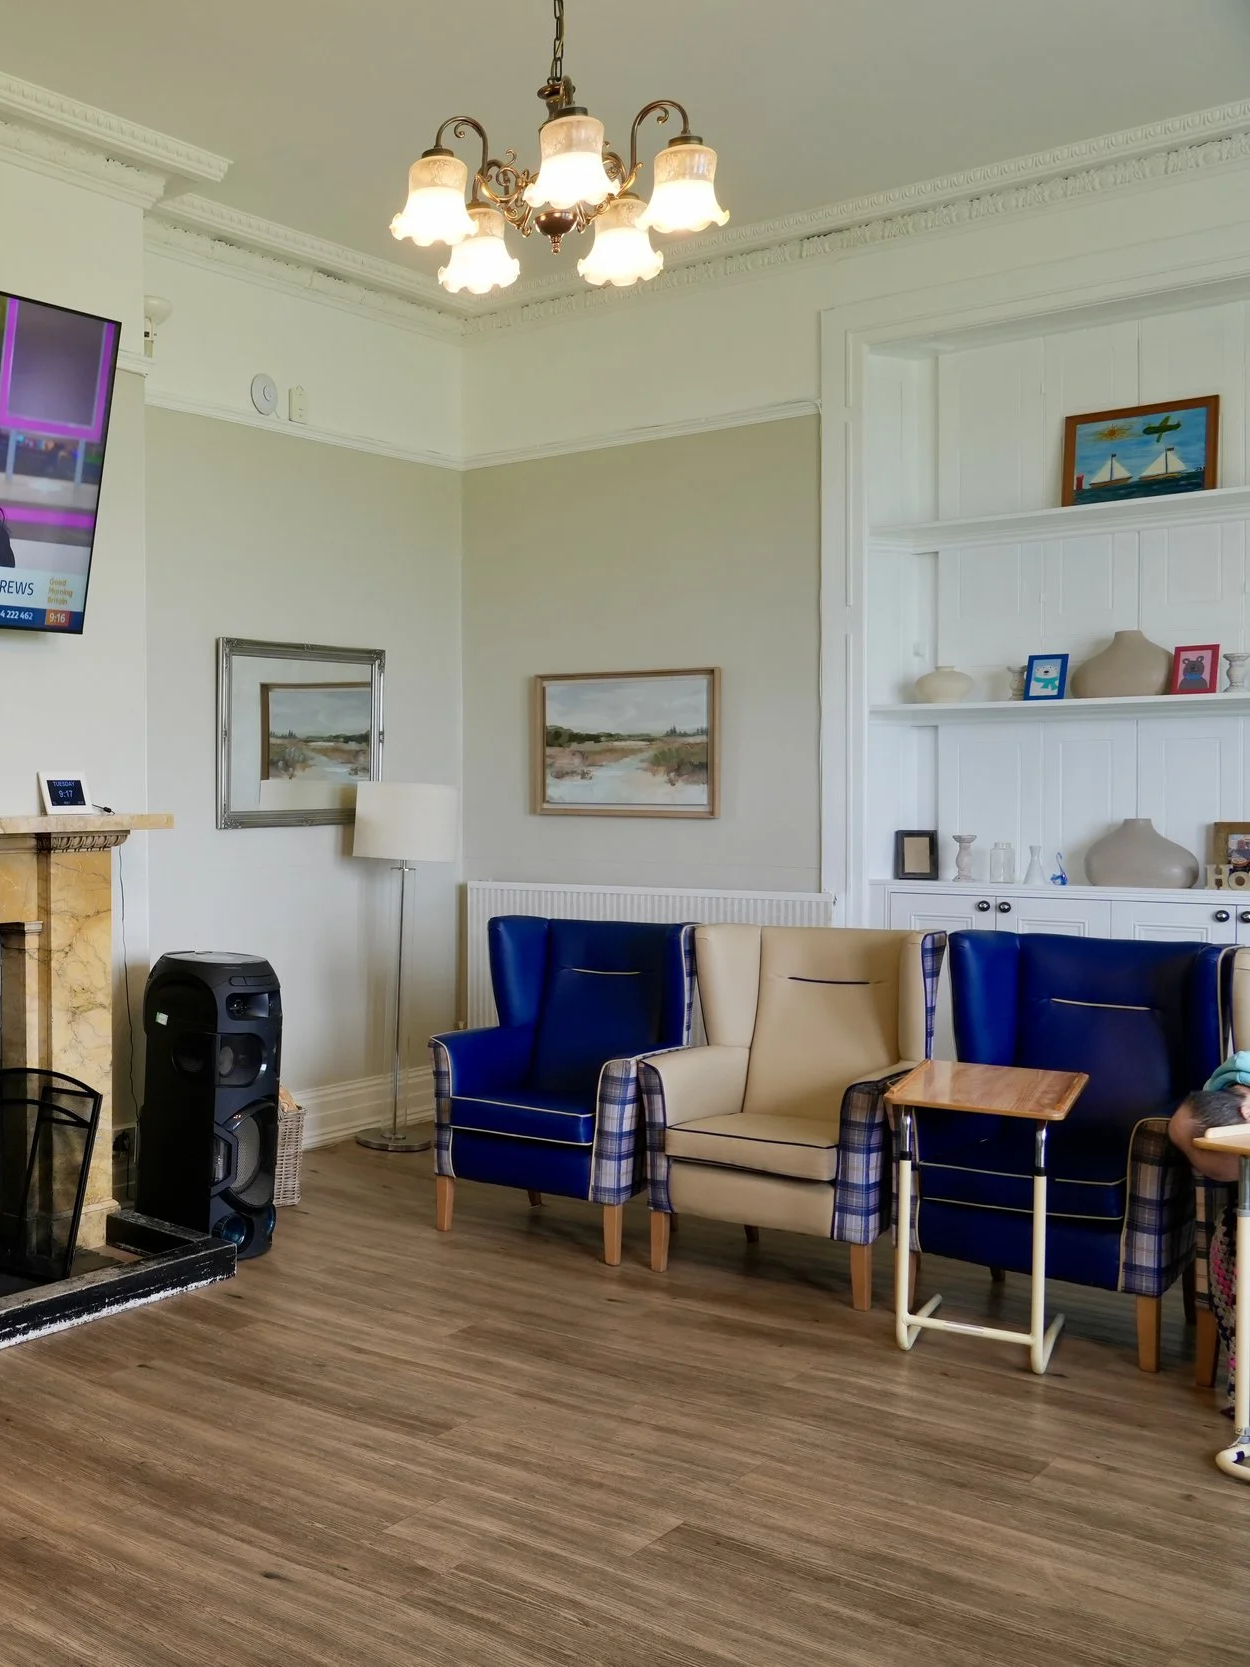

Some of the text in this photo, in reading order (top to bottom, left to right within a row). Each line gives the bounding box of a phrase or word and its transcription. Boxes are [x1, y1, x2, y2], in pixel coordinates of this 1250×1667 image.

[6, 610, 18, 619] 222
[20, 612, 33, 620] 462
[50, 613, 66, 623] 9:16
[59, 790, 73, 798] 9:17
